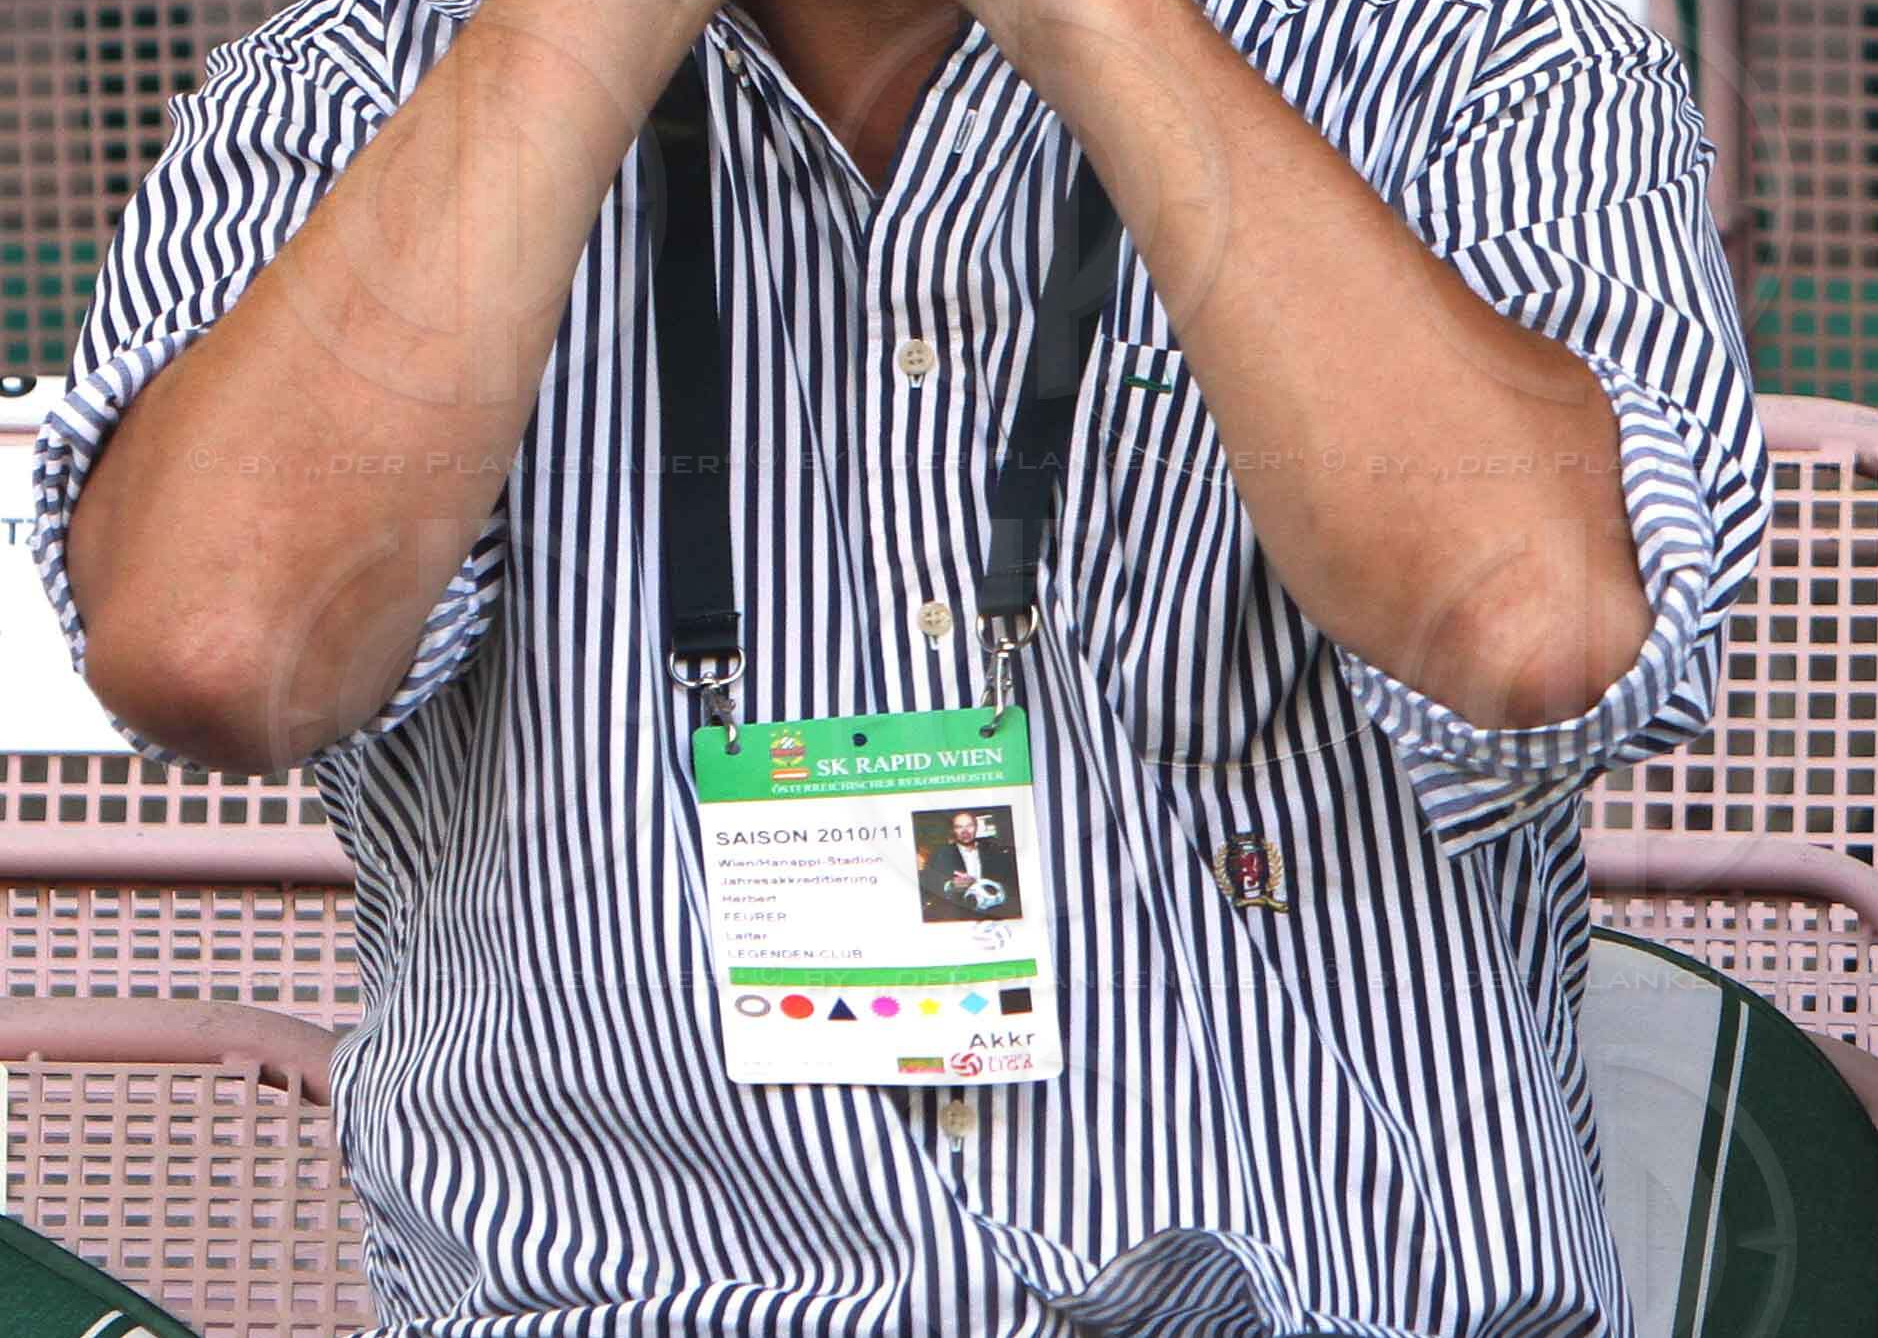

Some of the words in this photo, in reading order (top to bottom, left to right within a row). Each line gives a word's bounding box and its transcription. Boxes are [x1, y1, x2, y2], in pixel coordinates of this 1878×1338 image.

[817, 758, 849, 778] SK
[855, 752, 932, 774] RAPID
[937, 747, 1004, 767] WIEN
[715, 829, 808, 846] SAISON
[818, 825, 902, 843] 2010/11
[969, 1031, 1036, 1049] Akkr
